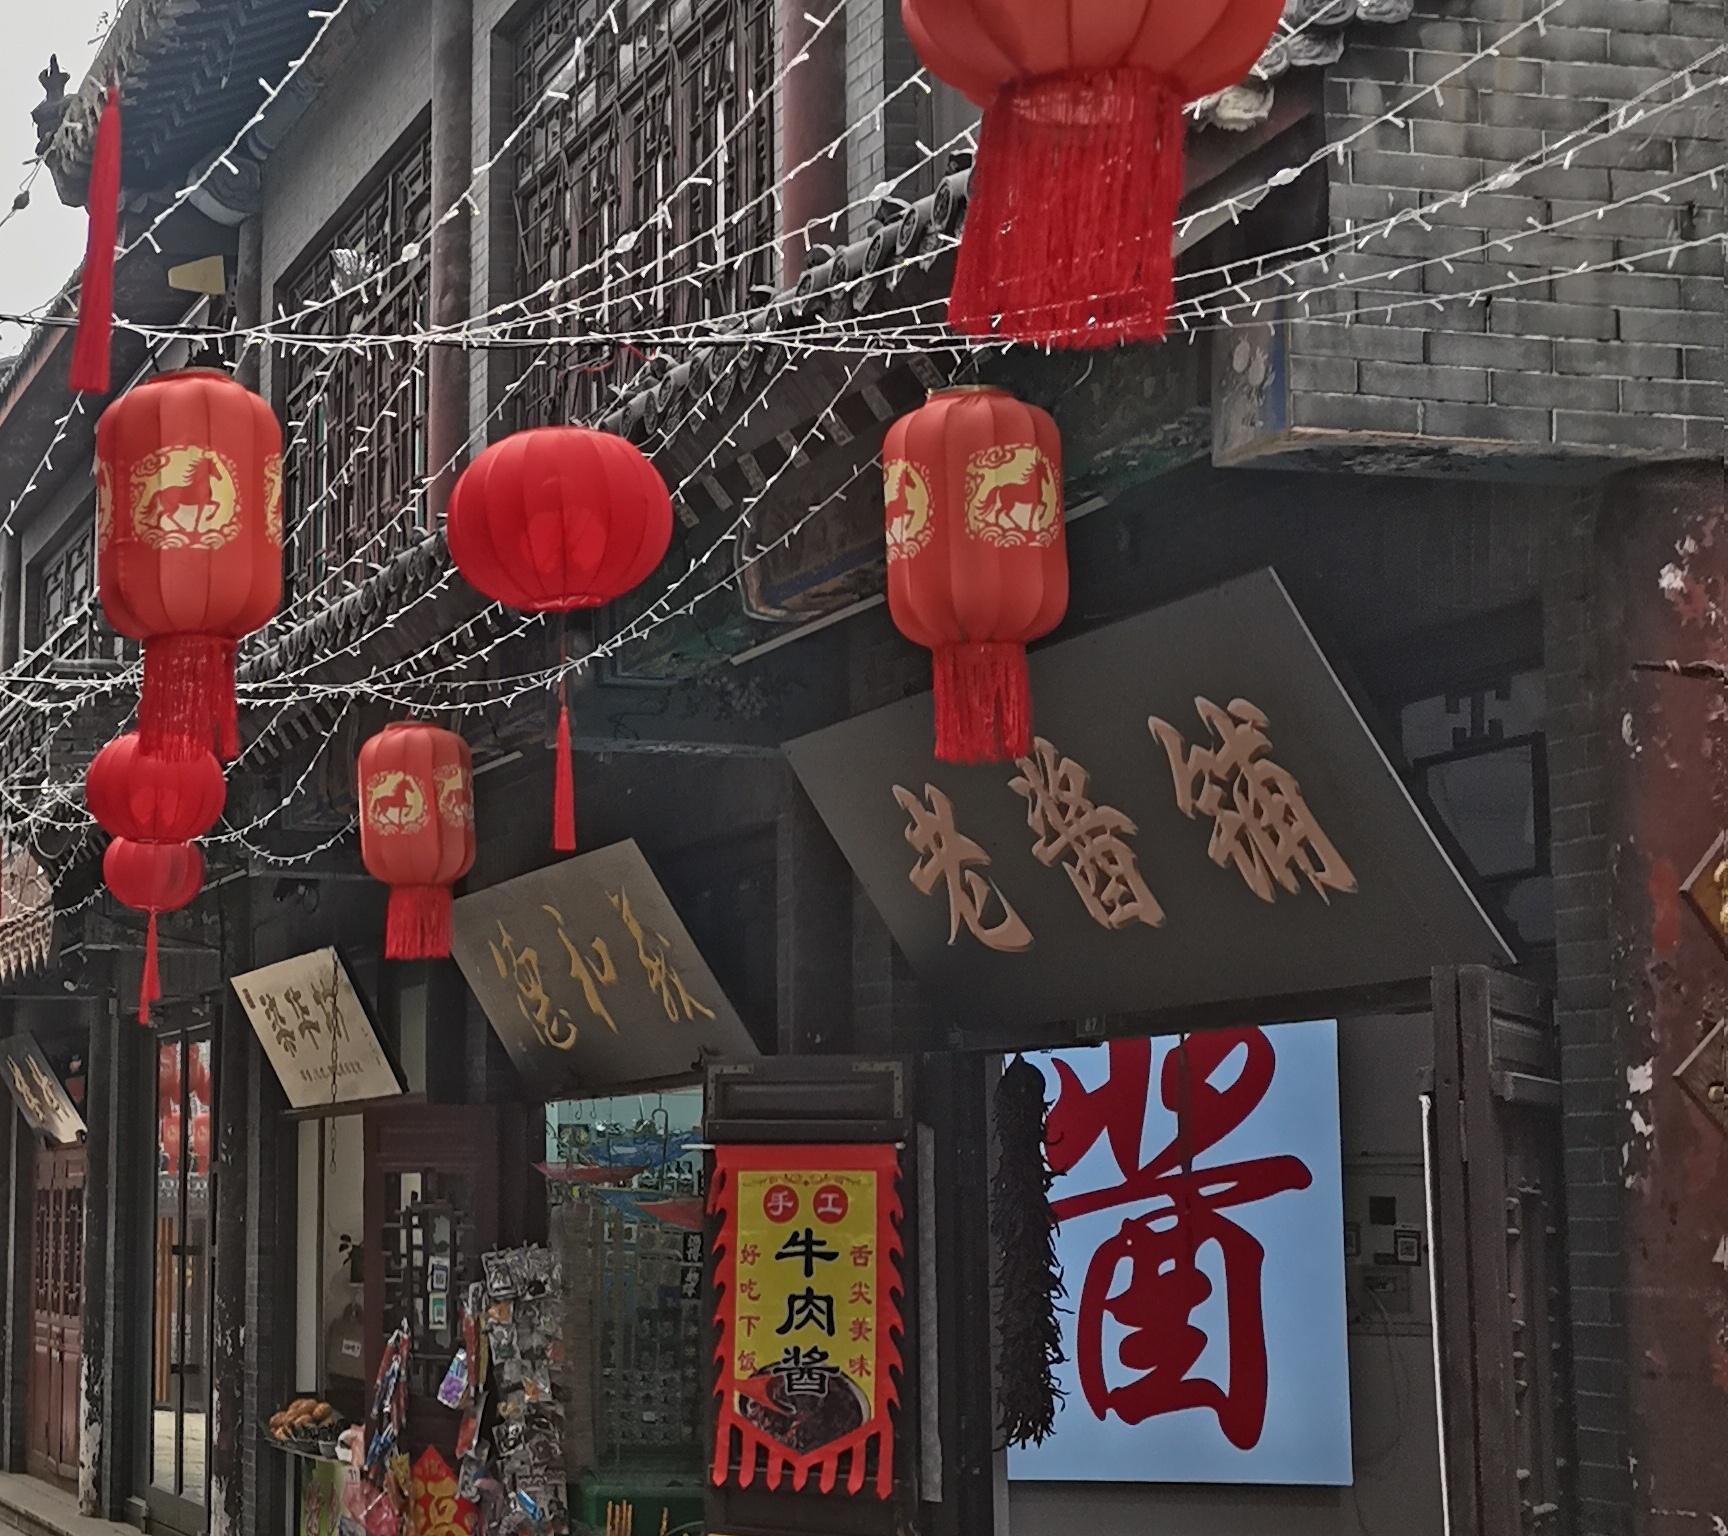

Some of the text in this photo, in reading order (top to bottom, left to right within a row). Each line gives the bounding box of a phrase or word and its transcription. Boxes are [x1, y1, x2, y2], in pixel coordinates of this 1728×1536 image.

[767, 1190, 843, 1216] 手工
[1045, 1025, 1313, 1452] 酱
[737, 1243, 761, 1374] 好吃下饭
[774, 1227, 840, 1396] 牛肉酱
[848, 1244, 873, 1379] 舌尖美味
